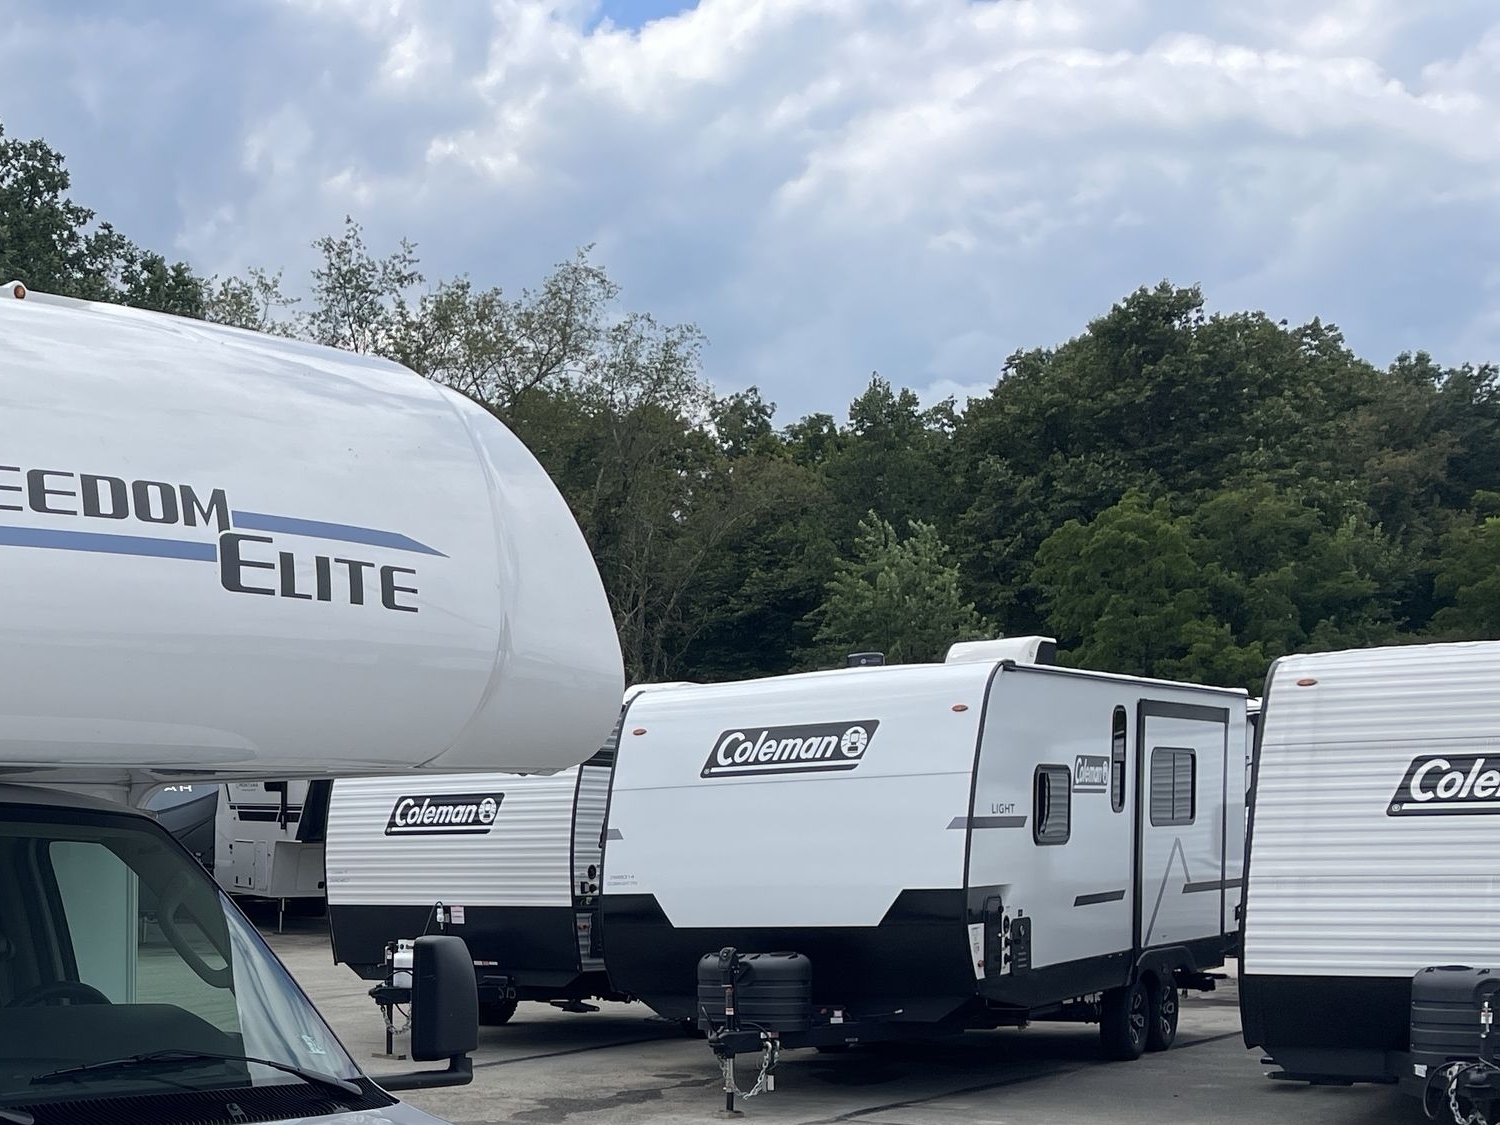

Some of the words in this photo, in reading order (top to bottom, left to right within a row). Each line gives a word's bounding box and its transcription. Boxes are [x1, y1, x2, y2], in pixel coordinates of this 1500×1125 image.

[219, 532, 419, 613] ELITE
[716, 730, 839, 767] Coleman
[1410, 757, 1500, 802] Cole
[395, 797, 478, 827] Coleman
[991, 803, 1016, 815] LIGHT
